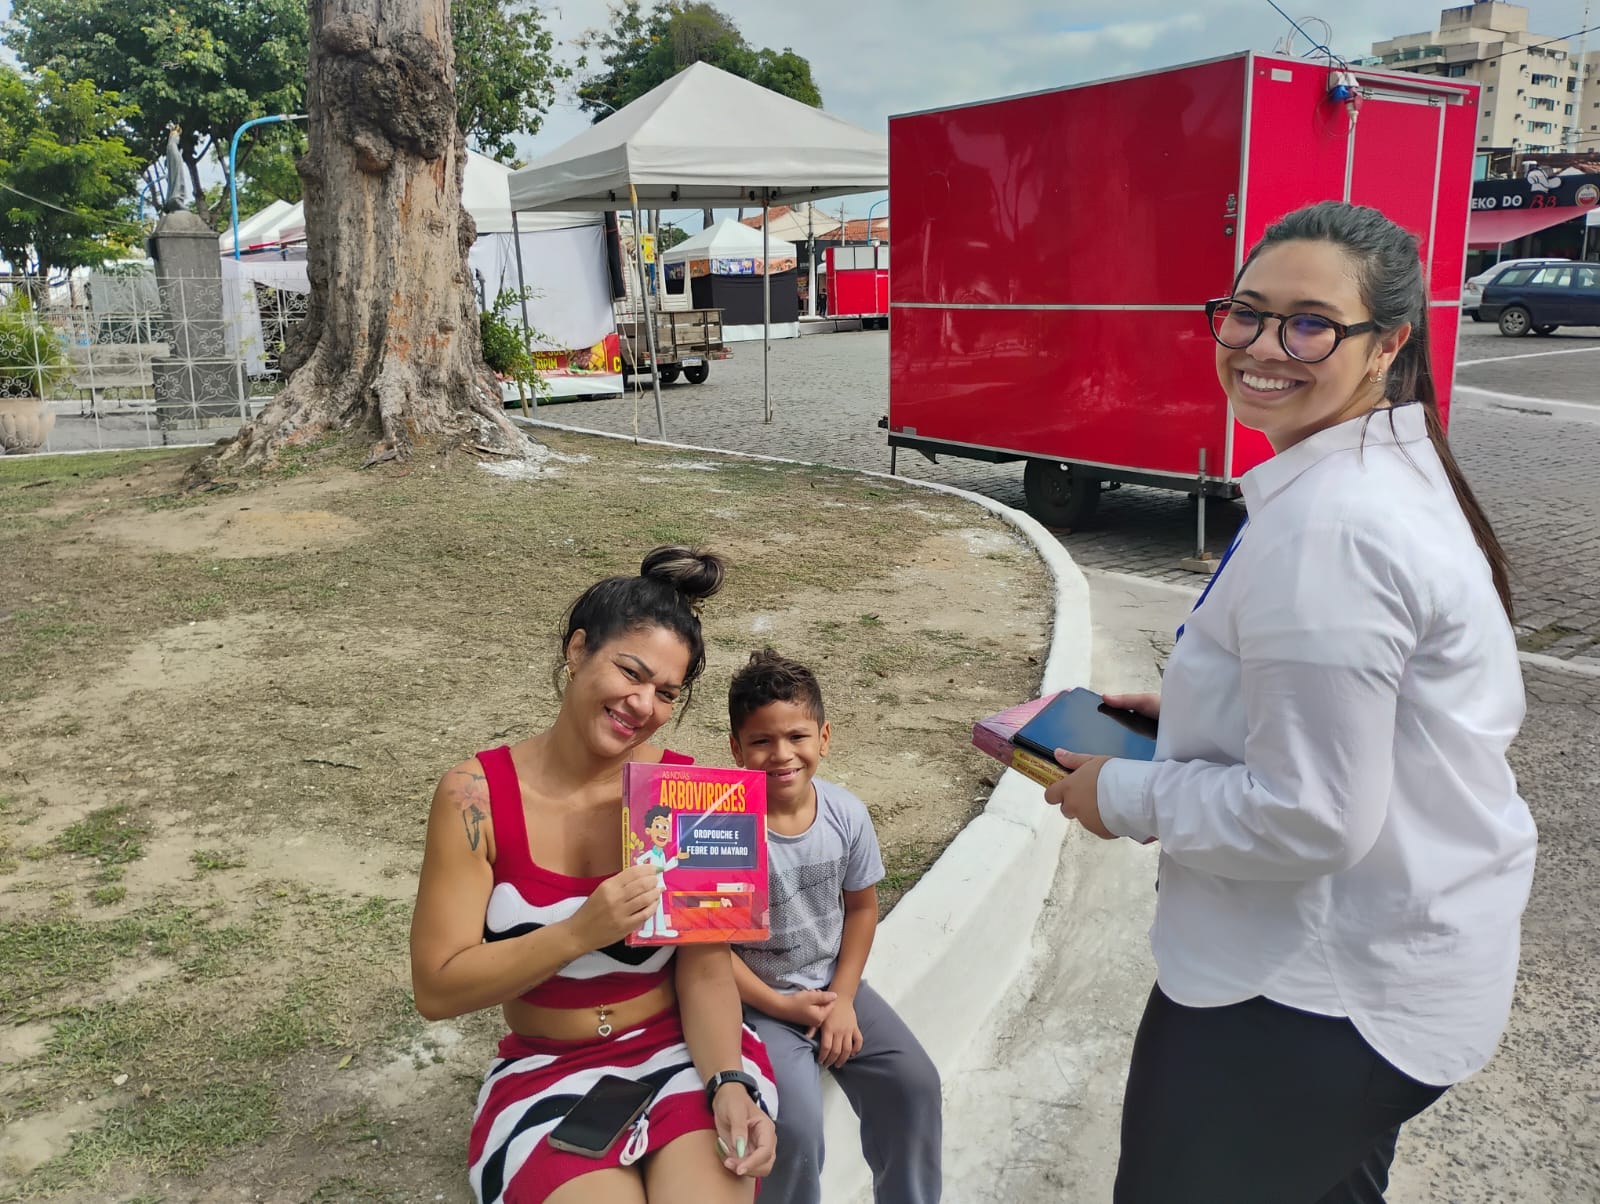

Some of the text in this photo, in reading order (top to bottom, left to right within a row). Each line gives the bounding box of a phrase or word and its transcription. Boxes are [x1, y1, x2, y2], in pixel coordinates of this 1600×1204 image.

[1472, 197, 1497, 209] EKO
[1502, 195, 1523, 207] DO
[659, 780, 746, 812] ARBOVIROSES
[693, 829, 740, 840] OROPOUCHE E
[687, 845, 709, 855] FEBRE
[709, 846, 719, 855] DO
